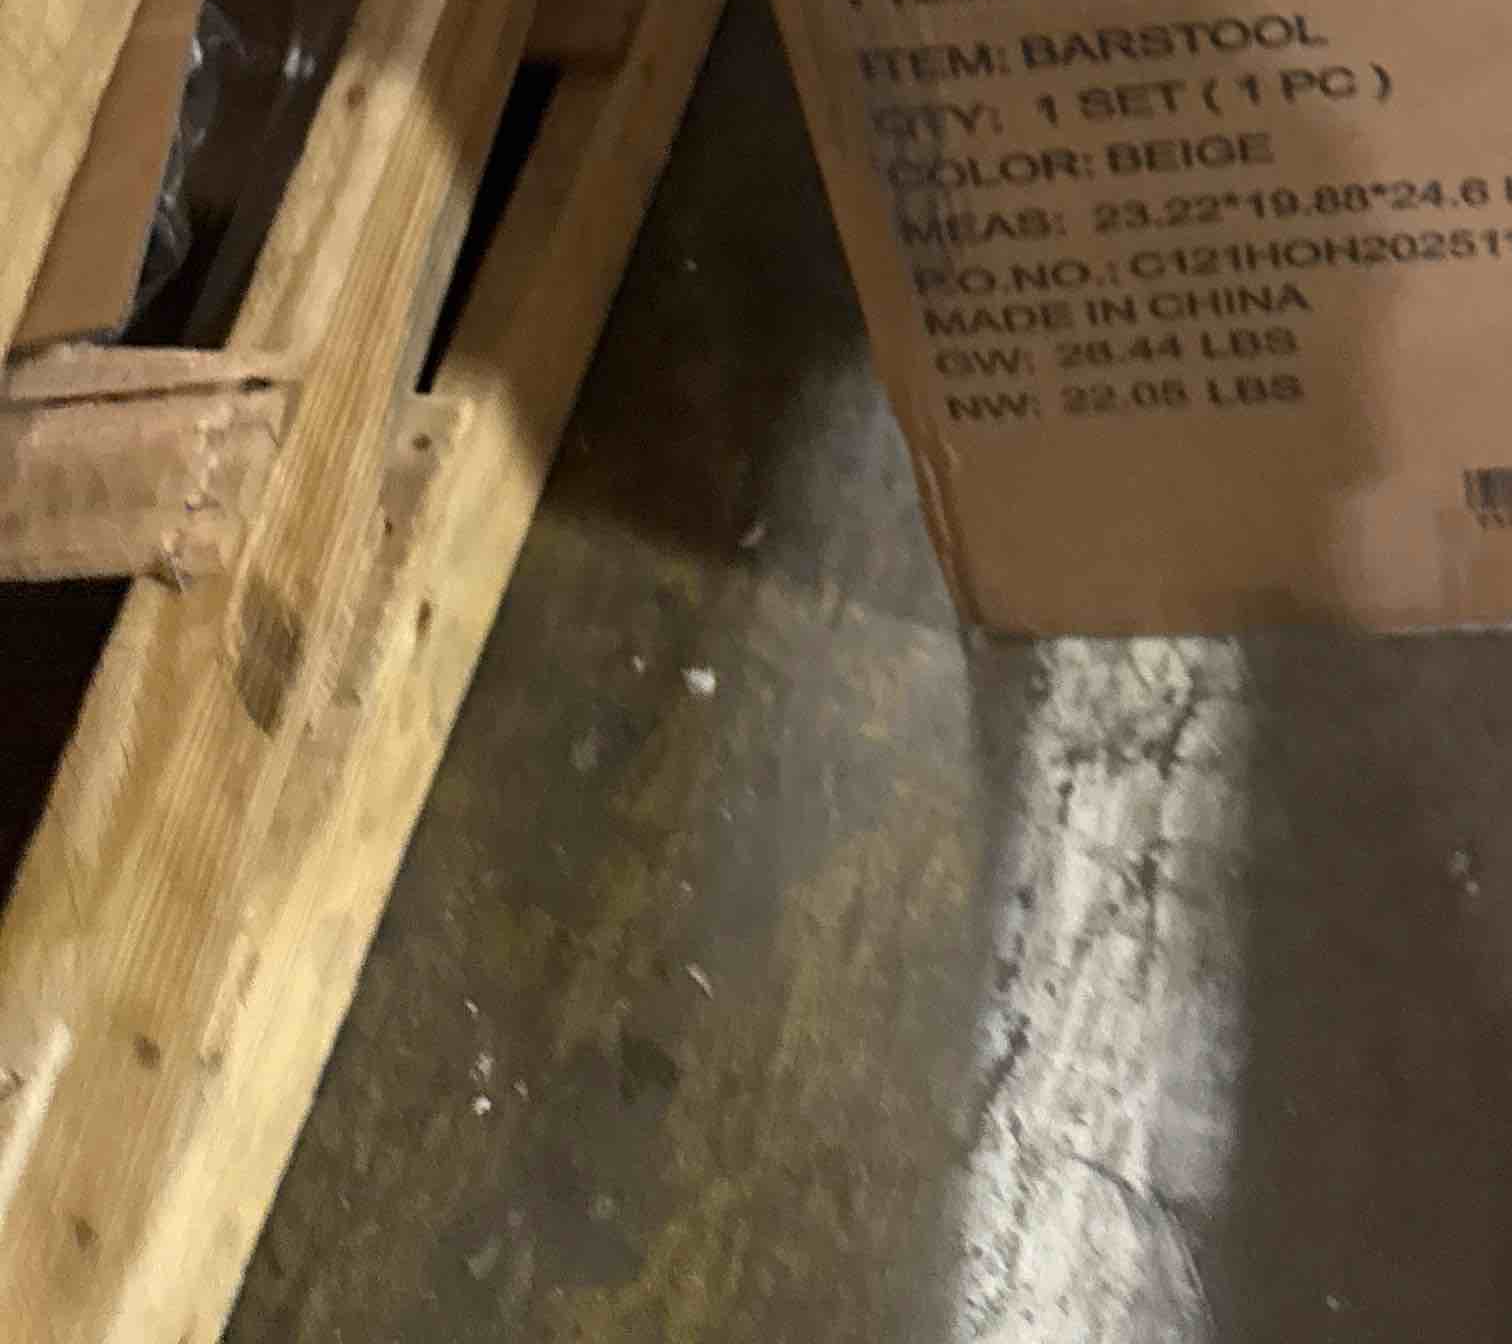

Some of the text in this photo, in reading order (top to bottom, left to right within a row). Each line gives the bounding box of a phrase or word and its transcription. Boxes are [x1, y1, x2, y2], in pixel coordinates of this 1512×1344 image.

[857, 13, 1329, 83] ITEM: BARSTOOL
[1035, 92, 1060, 128] 1
[1075, 79, 1187, 122] SET
[888, 132, 1275, 190] COLOR: BEIGE
[900, 204, 1068, 248] MEAS:
[922, 281, 1315, 338] MADE IN CHINA
[934, 345, 1037, 377] GW:
[1199, 325, 1299, 362] LBS
[945, 391, 1042, 424] NW:
[1206, 373, 1306, 408] LBS
